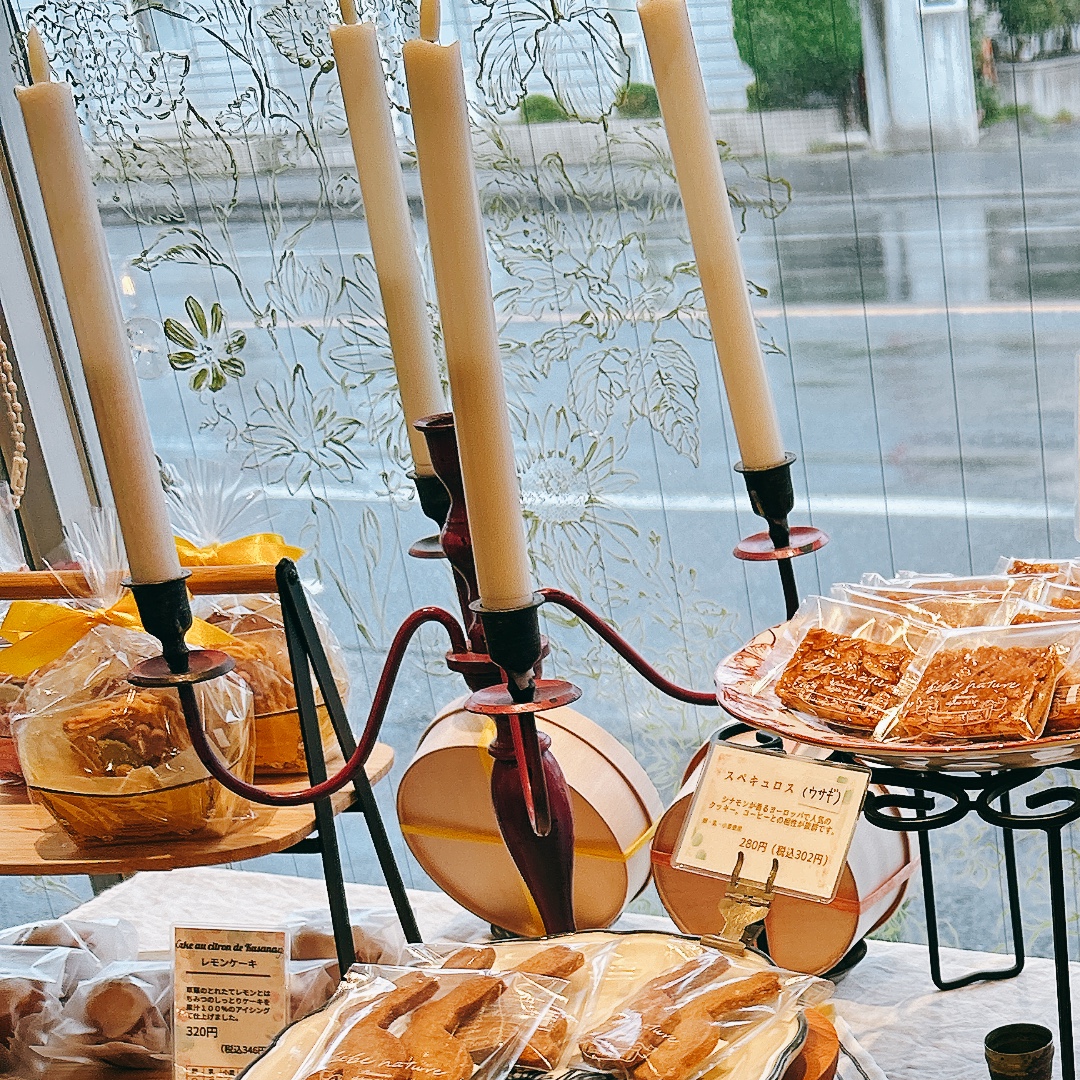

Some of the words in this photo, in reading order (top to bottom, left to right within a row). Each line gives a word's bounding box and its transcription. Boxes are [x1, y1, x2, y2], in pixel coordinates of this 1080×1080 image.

[233, 943, 243, 952] de
[201, 958, 257, 968] レモンケーキ
[186, 996, 270, 1006] ちみつのしっとりケーキを
[186, 1026, 218, 1038] 320円
